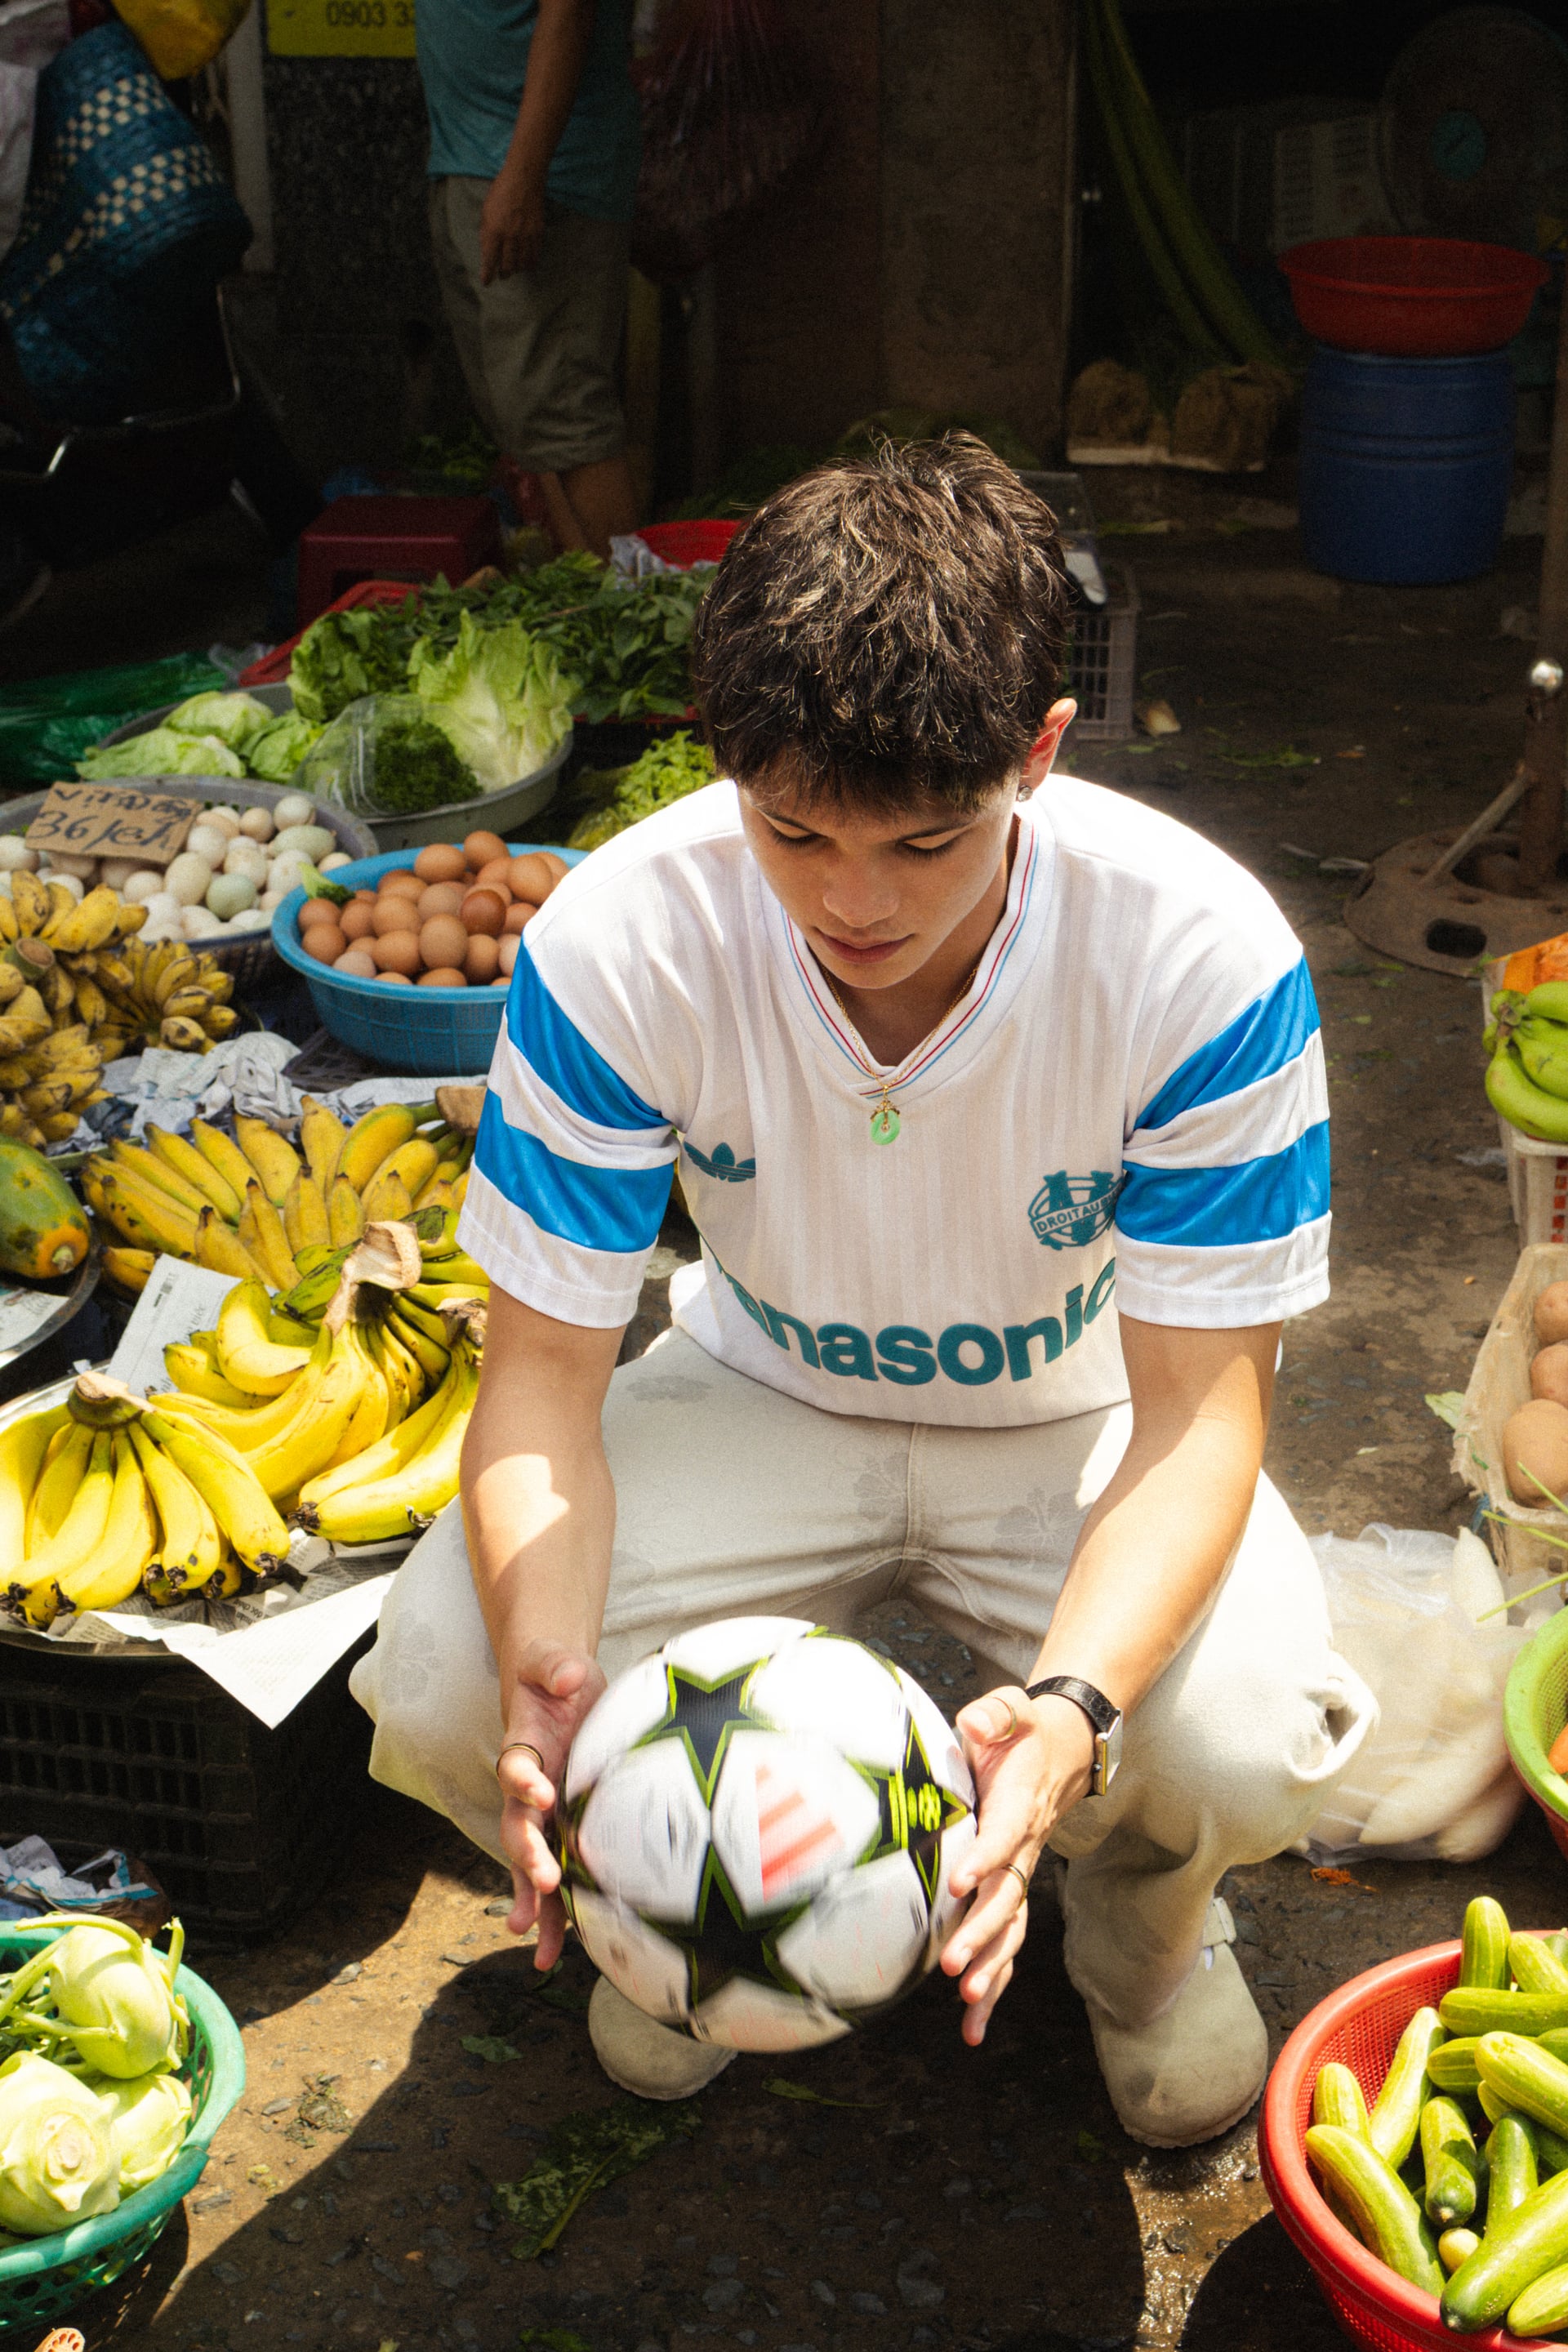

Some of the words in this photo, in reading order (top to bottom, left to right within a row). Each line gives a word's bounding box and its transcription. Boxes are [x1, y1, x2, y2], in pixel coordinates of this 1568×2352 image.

[327, 1, 385, 27] 0903
[1036, 1208, 1080, 1232] DROIT
[712, 1258, 1117, 1386] anasonic
